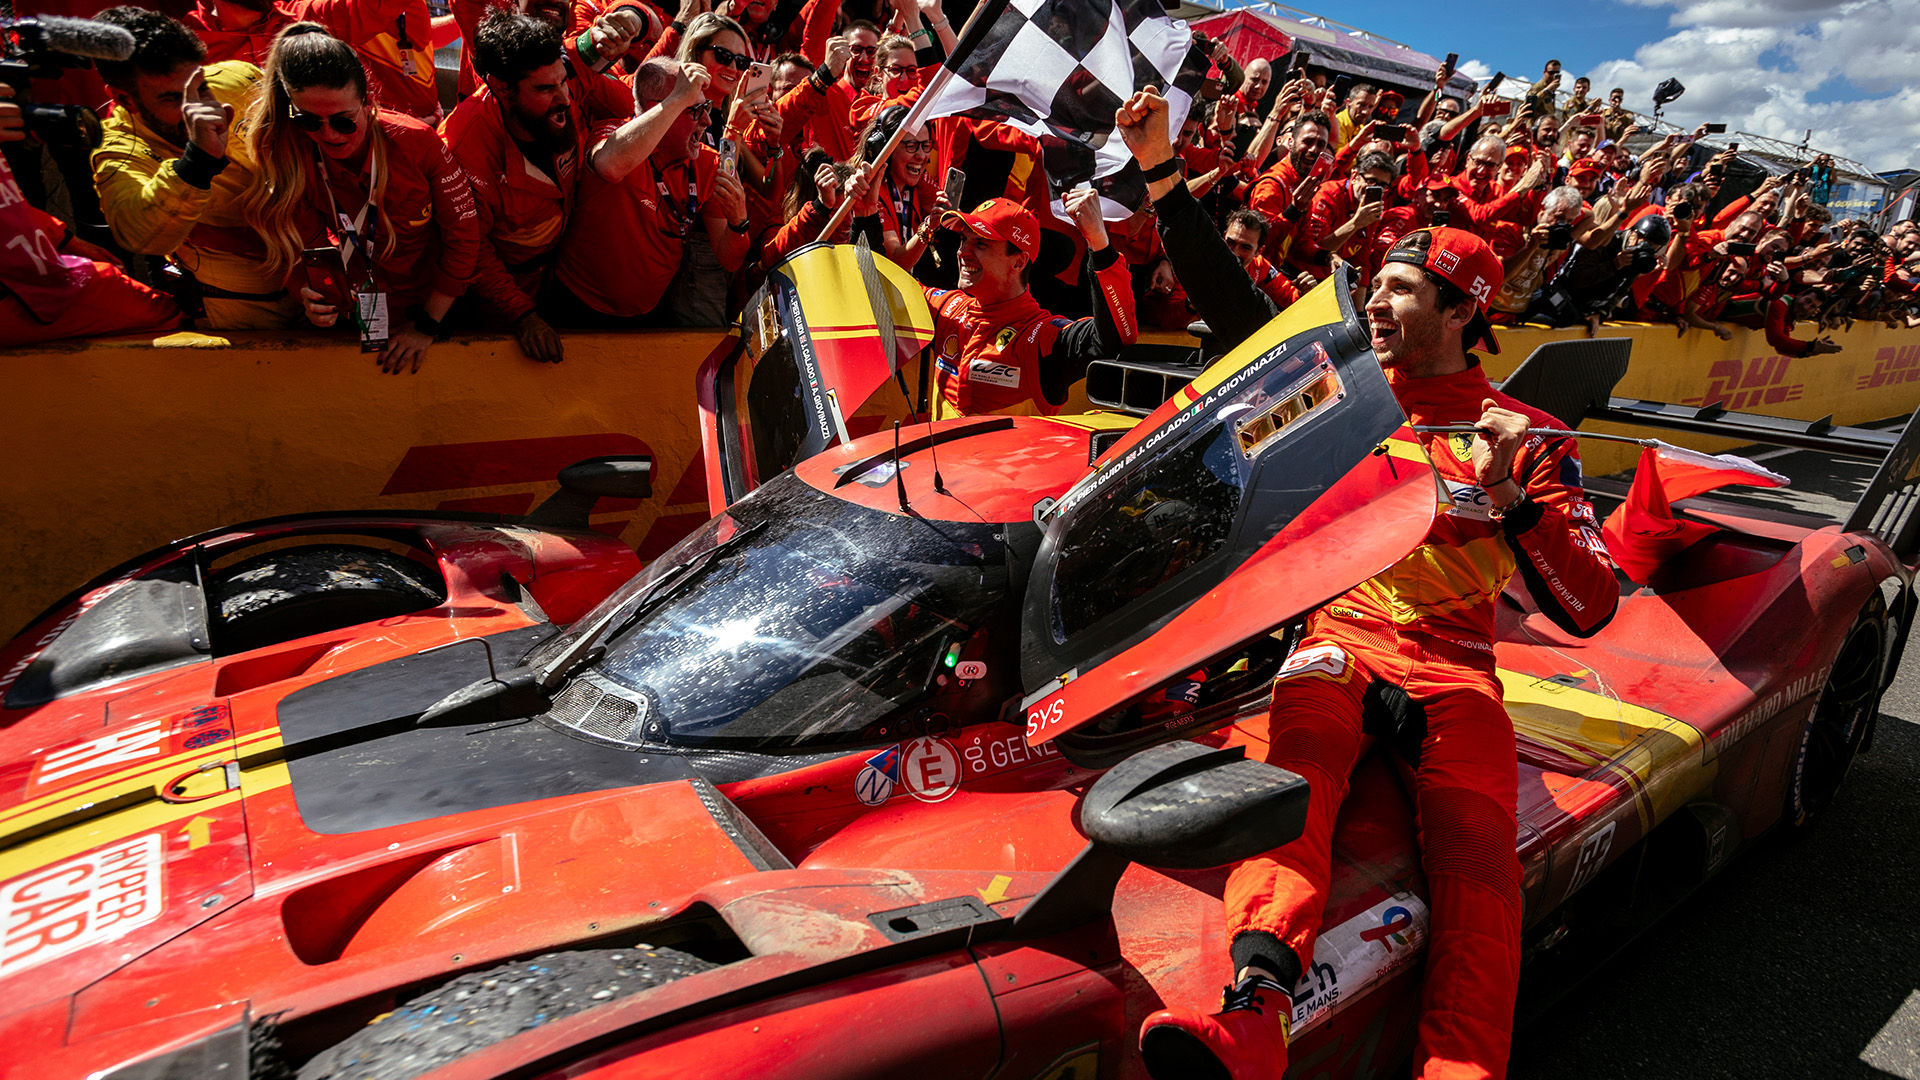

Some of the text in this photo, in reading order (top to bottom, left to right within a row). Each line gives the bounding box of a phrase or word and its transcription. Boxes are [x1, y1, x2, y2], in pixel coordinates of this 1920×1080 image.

[1469, 275, 1492, 304] 51
[791, 301, 801, 318] PIER
[795, 316, 805, 336] GUIDI
[802, 349, 816, 379] CALADO
[974, 363, 1017, 377] WEC
[1204, 396, 1217, 408] A.
[1217, 343, 1287, 394] GIOVINAZZI
[1703, 356, 1790, 410] DHL
[811, 387, 831, 440] A. GIOVINAZZI
[1136, 412, 1190, 458] J. CALADO
[1067, 460, 1124, 511] A. PIER GUIDI
[1551, 577, 1586, 612] RICHARD
[1026, 699, 1065, 738] SYS
[1720, 691, 1783, 753] RICHARD
[1783, 666, 1827, 708] MILLE
[919, 755, 946, 791] E
[95, 841, 149, 931] HYPER
[1, 863, 95, 967] CAR
[1305, 987, 1340, 1016] MANS
